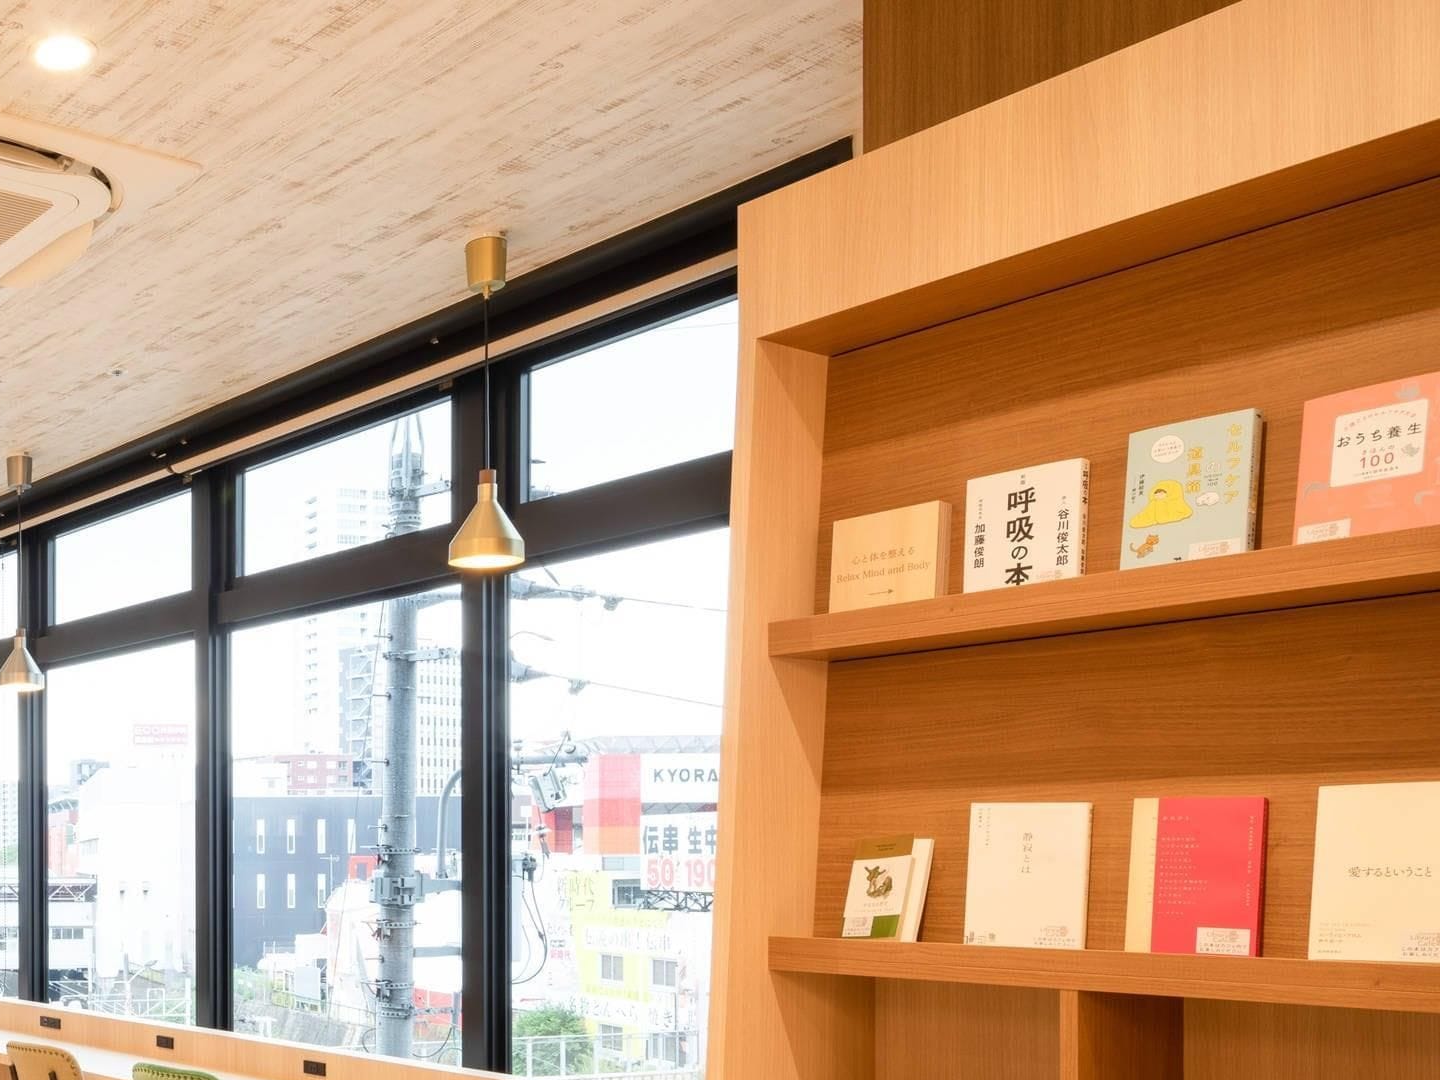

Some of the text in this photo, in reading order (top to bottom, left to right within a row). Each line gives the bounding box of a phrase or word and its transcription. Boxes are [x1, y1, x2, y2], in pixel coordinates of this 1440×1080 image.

[1336, 422, 1423, 448] おうち養生
[1224, 423, 1242, 504] セルフケア
[1360, 453, 1395, 469] 100
[973, 523, 986, 569] 加藤俊朗
[1004, 486, 1036, 586] 呼吸の本
[1055, 508, 1069, 566] 谷川俊太郎
[851, 546, 916, 566] 心と体を整える
[836, 560, 930, 584] Relax Mind and Body
[653, 768, 718, 783] KYORA
[642, 825, 679, 855] 伝串
[647, 858, 674, 887] 50
[1347, 865, 1432, 879] 愛するということ
